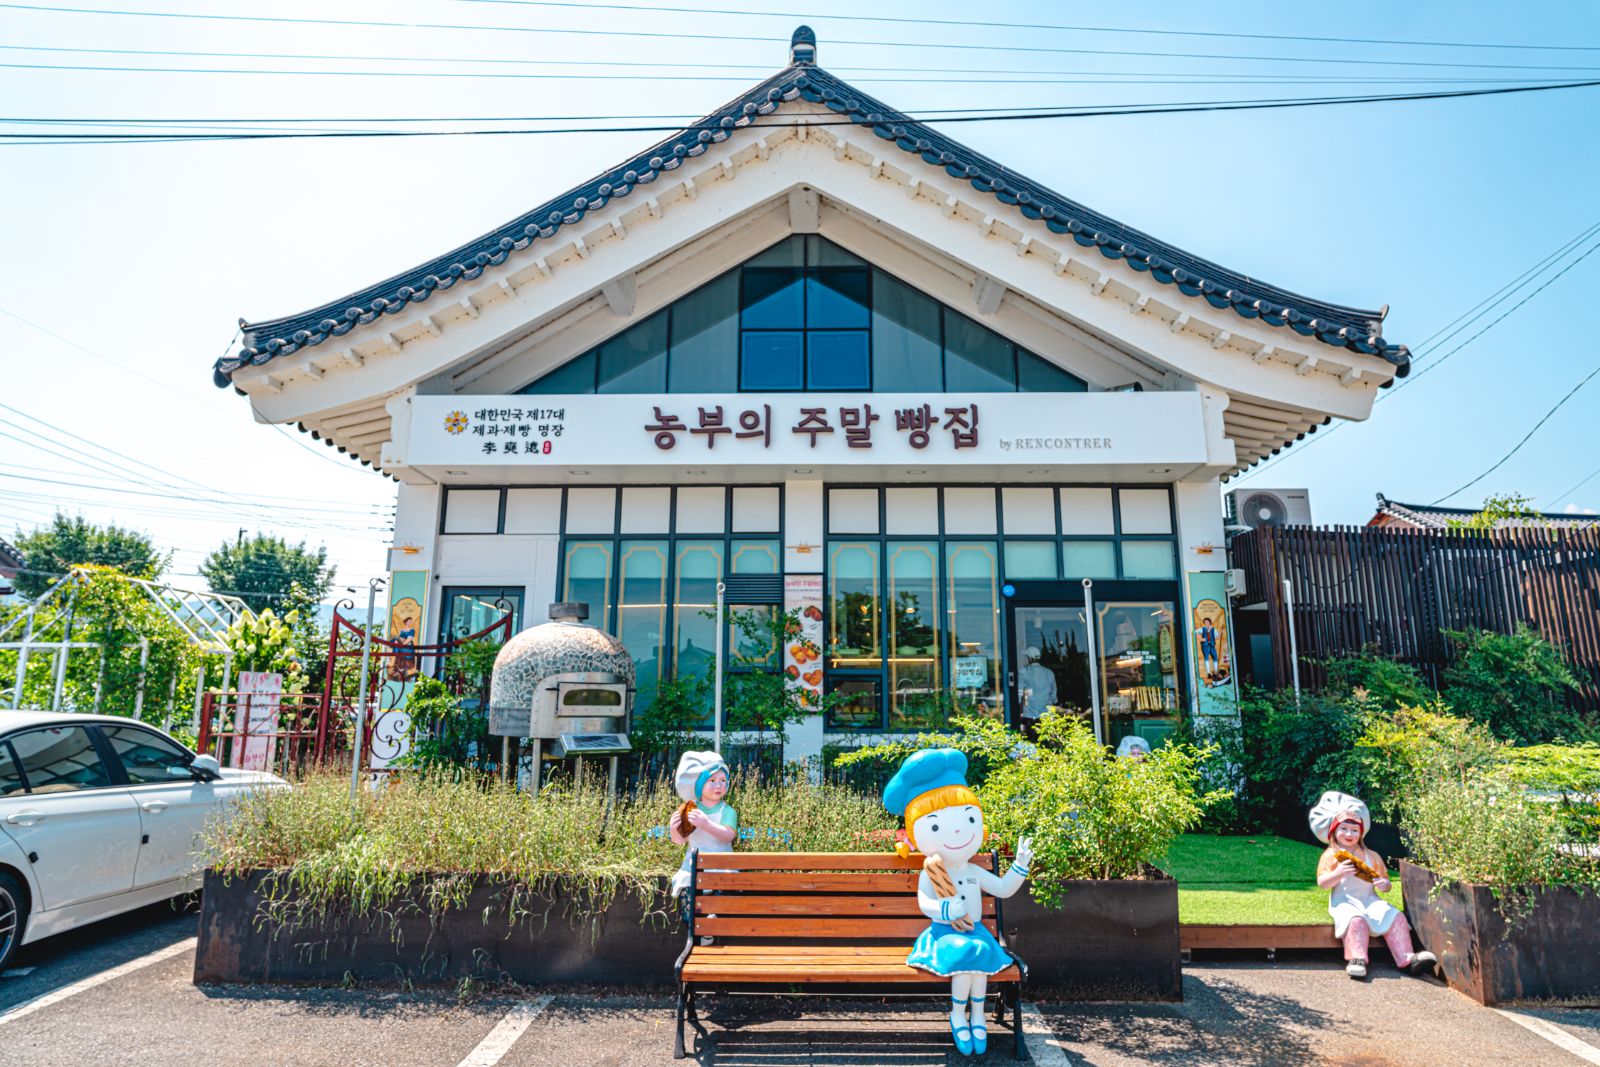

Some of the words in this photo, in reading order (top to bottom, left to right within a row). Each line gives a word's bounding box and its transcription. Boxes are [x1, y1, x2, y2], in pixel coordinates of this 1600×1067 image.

[474, 408, 524, 421] 대한민국
[526, 408, 565, 421] 제17대
[538, 424, 564, 437] 명장
[644, 403, 771, 450] 농부의
[791, 403, 880, 449] 주말
[894, 403, 979, 450] 빵집
[999, 438, 1012, 452] by
[1015, 437, 1112, 449] RENCONTRER
